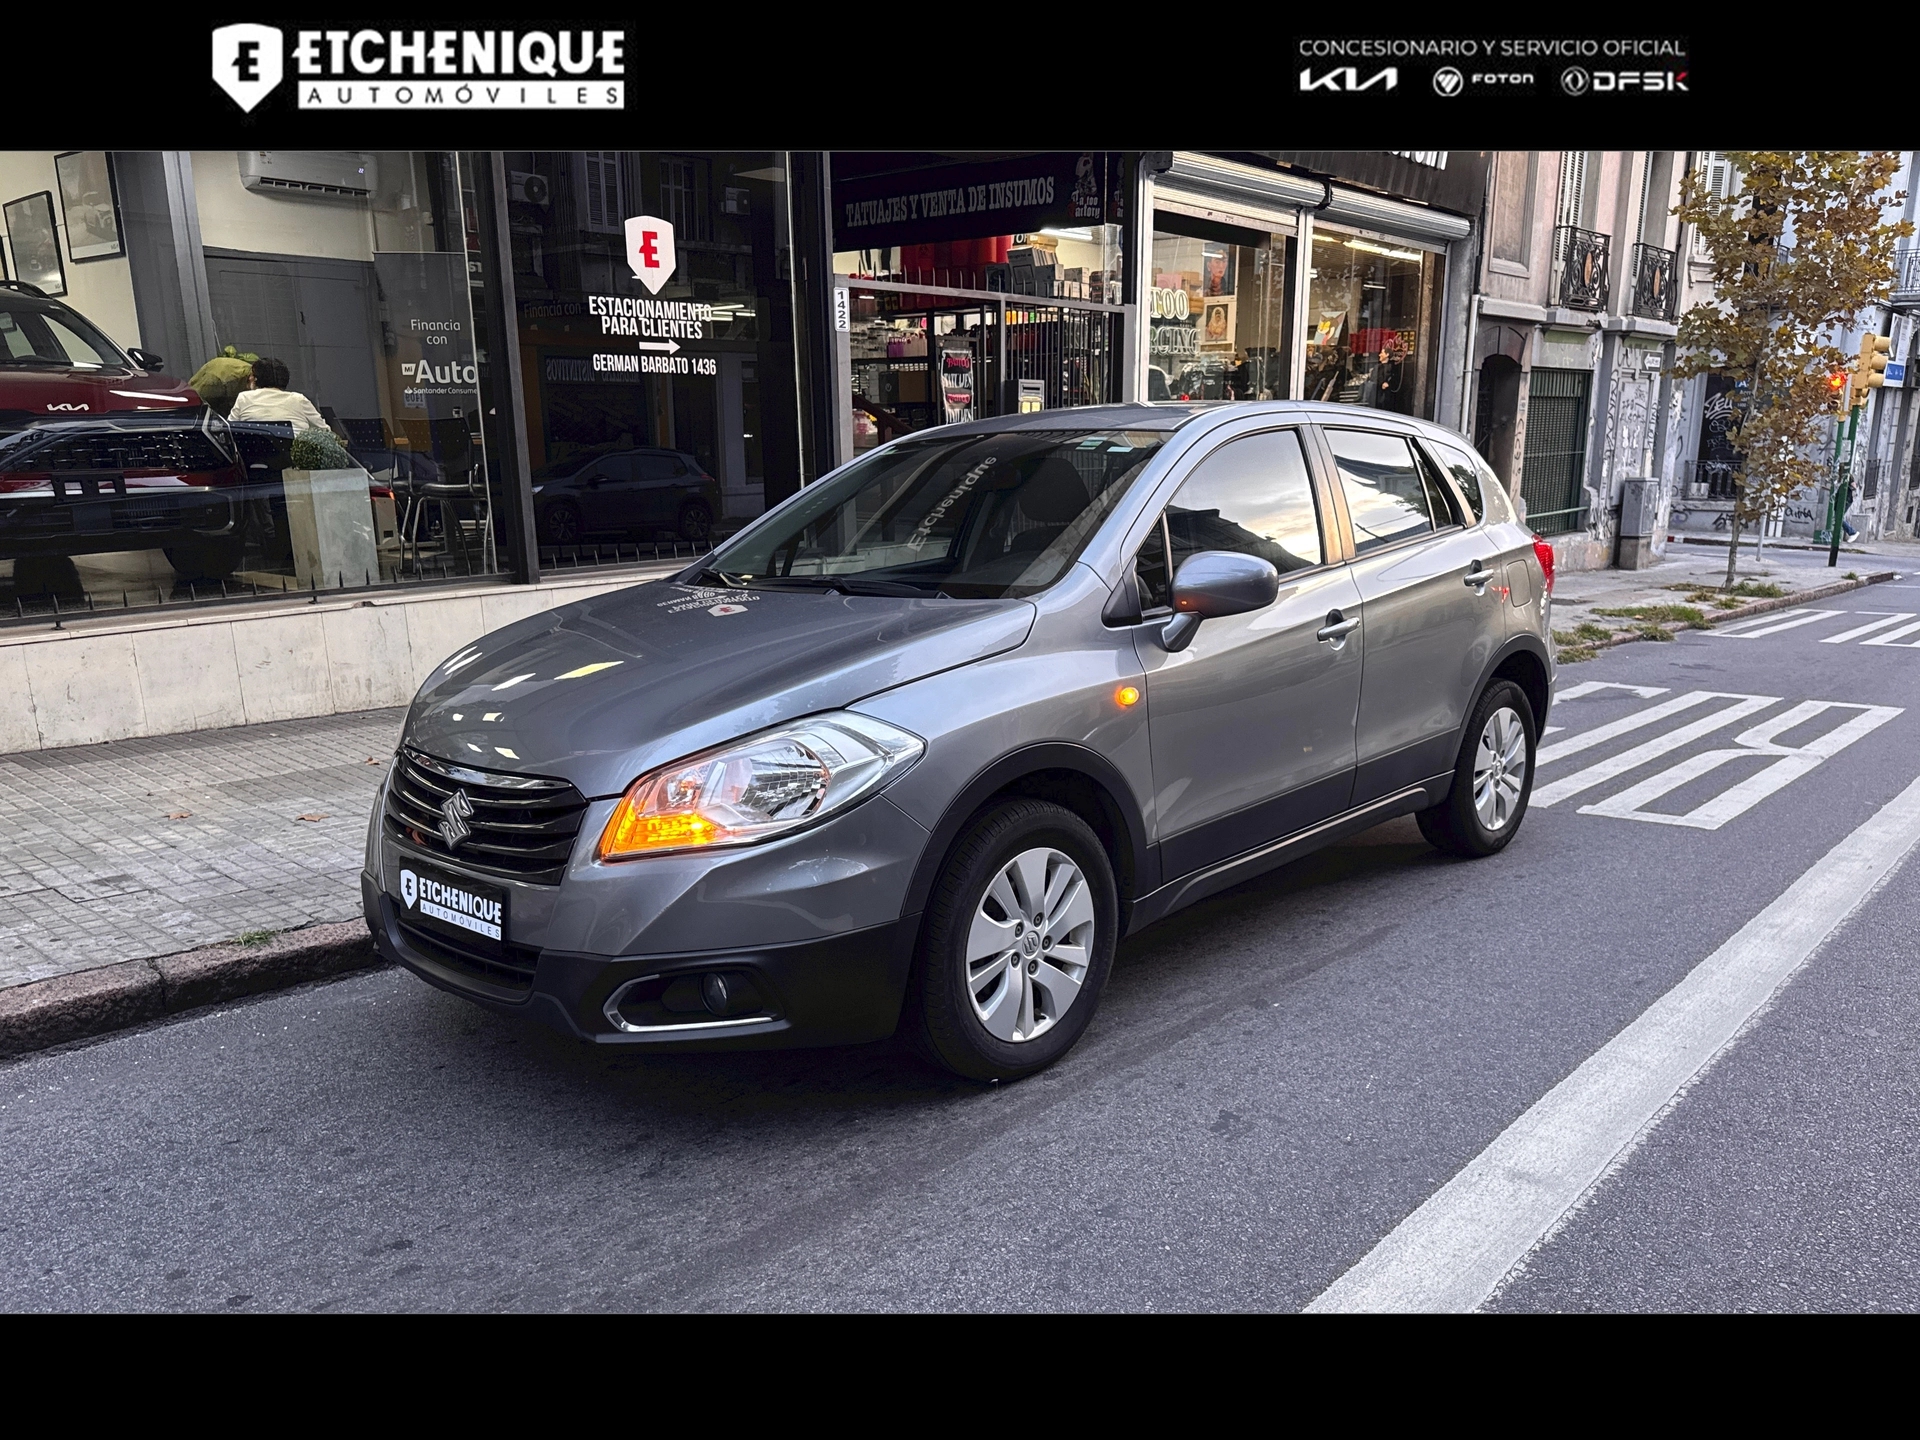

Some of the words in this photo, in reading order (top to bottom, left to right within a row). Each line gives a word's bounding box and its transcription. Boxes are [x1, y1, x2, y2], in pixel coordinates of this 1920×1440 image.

[845, 197, 908, 228] TATUAJES
[908, 194, 919, 220] Y
[920, 187, 966, 219] VENTA
[968, 184, 986, 213] DE
[988, 176, 1055, 211] INSUMOS
[588, 295, 712, 322] ESTACIONAMIENTO
[837, 291, 846, 329] 1422
[411, 319, 460, 331] Financia
[602, 316, 639, 336] PARA
[640, 317, 703, 339] CLIENTES
[426, 335, 448, 344] con
[415, 359, 478, 384] Auto
[592, 354, 639, 373] GERMAN
[641, 356, 689, 375] BARBATO
[691, 358, 717, 375] 1436
[413, 387, 447, 395] Santander
[46, 403, 90, 411] KIA
[419, 877, 502, 925] ETCHENIQUE
[422, 903, 501, 939] AUTOMÓVILES
